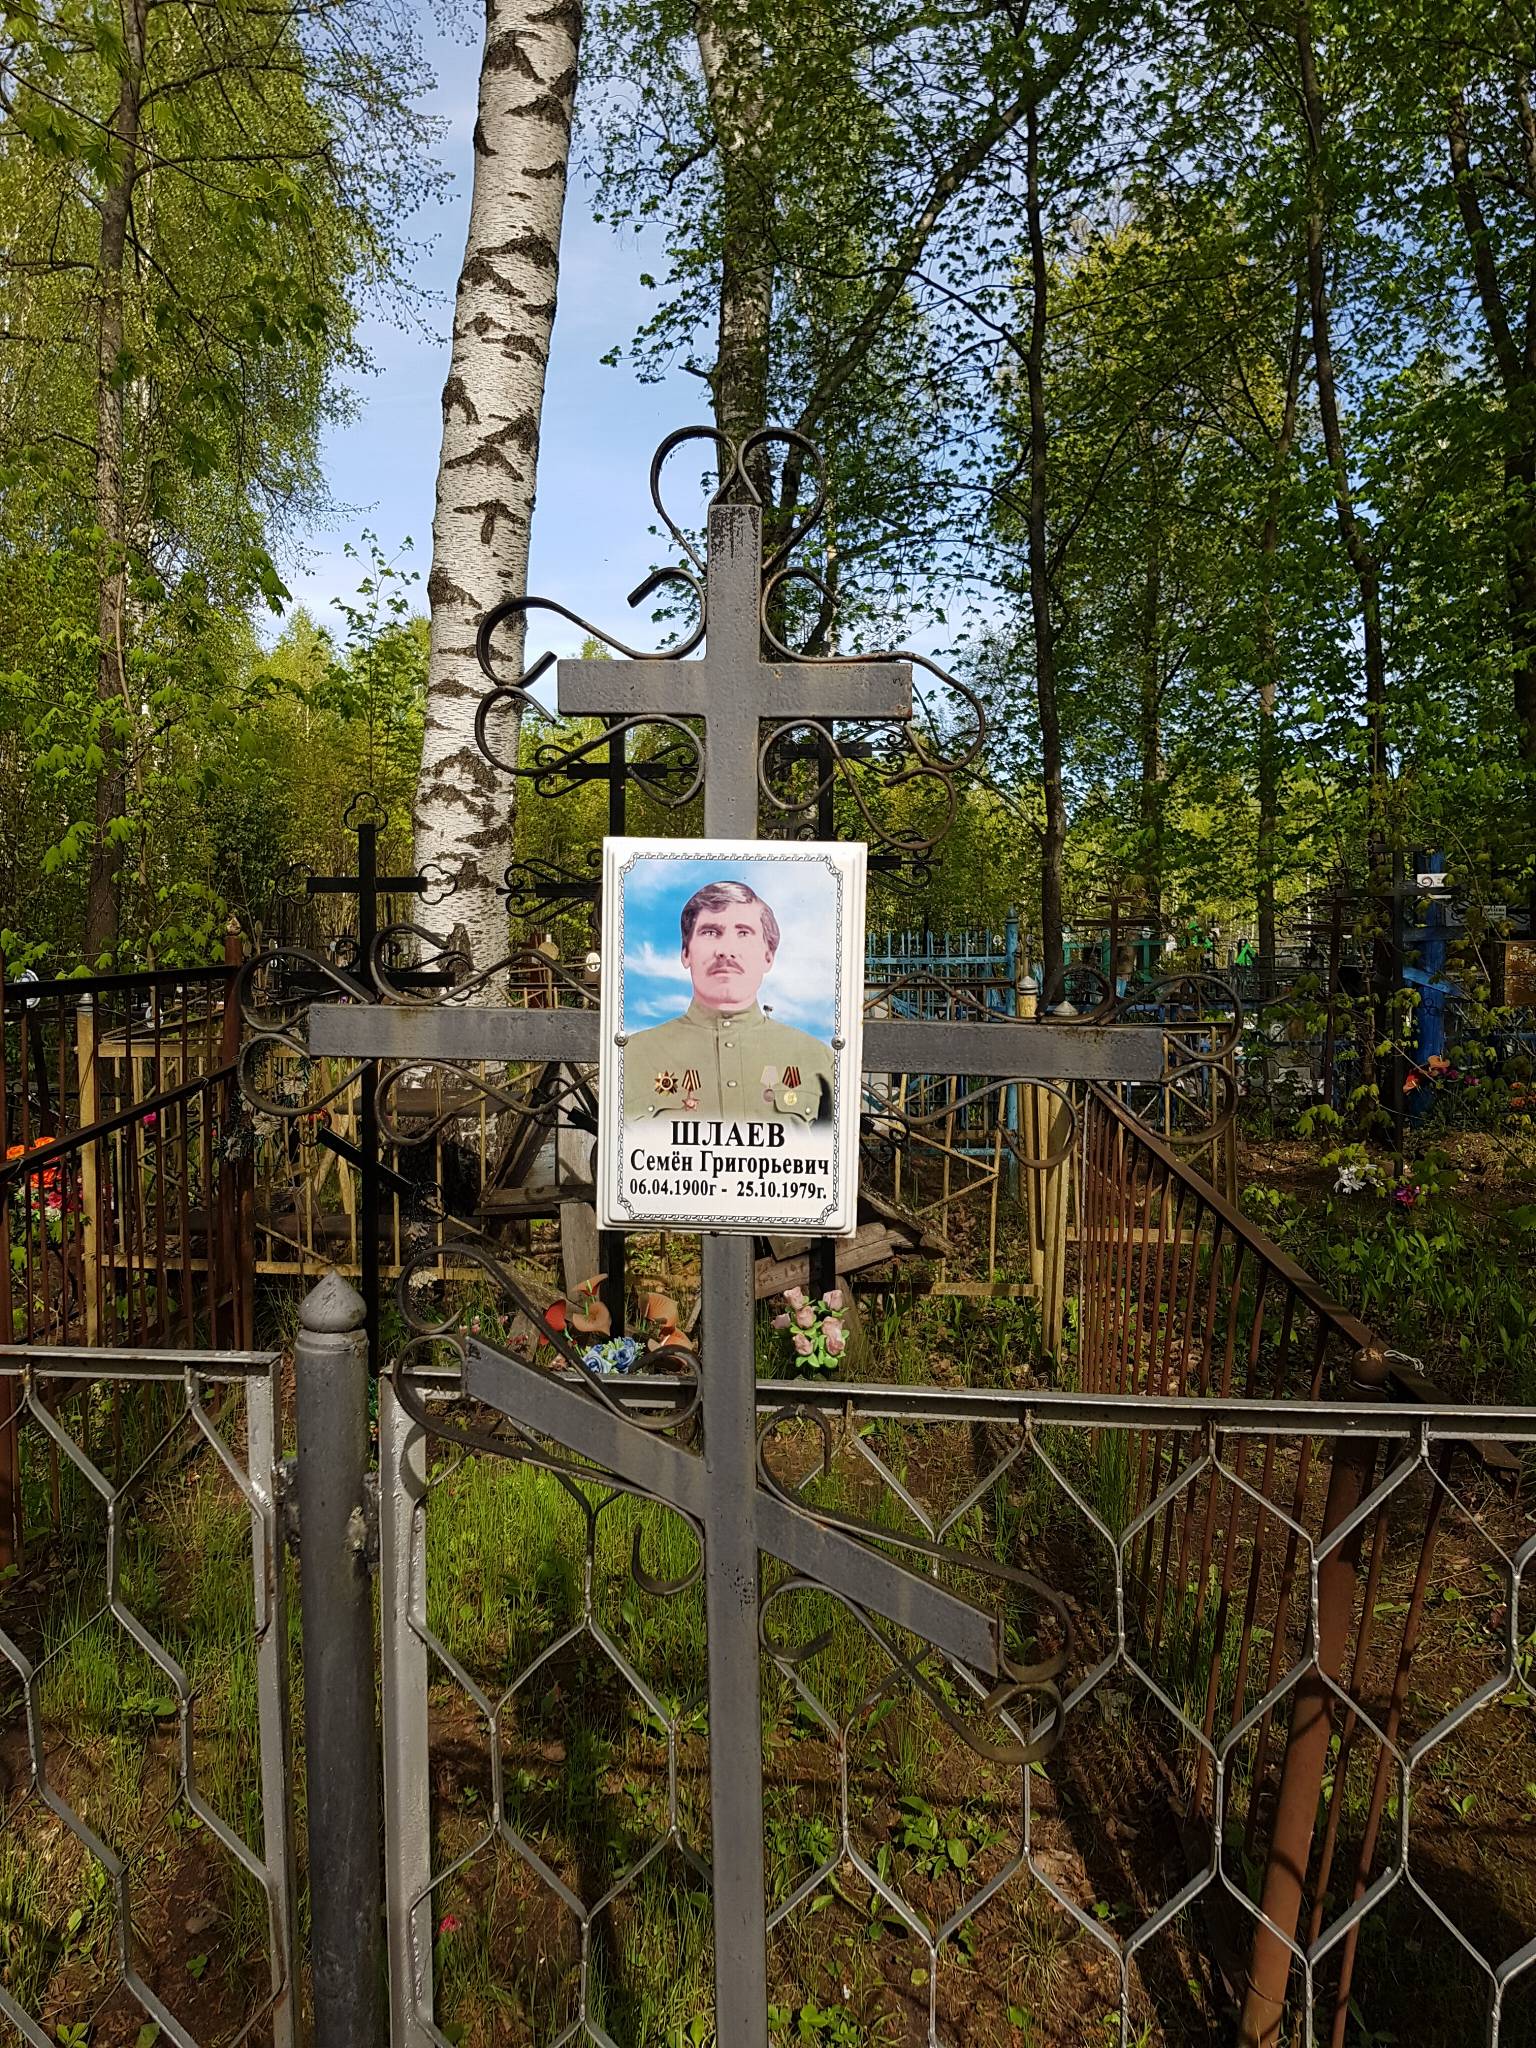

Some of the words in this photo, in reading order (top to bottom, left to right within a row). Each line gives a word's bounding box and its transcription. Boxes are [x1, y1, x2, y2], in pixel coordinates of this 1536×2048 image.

[671, 1120, 785, 1147] ШЛАЕВ
[630, 1149, 693, 1172] Семён
[700, 1150, 829, 1179] Григорьевич
[630, 1179, 717, 1196] 06.04.1900г
[736, 1181, 827, 1200] 25.10.1979г.
